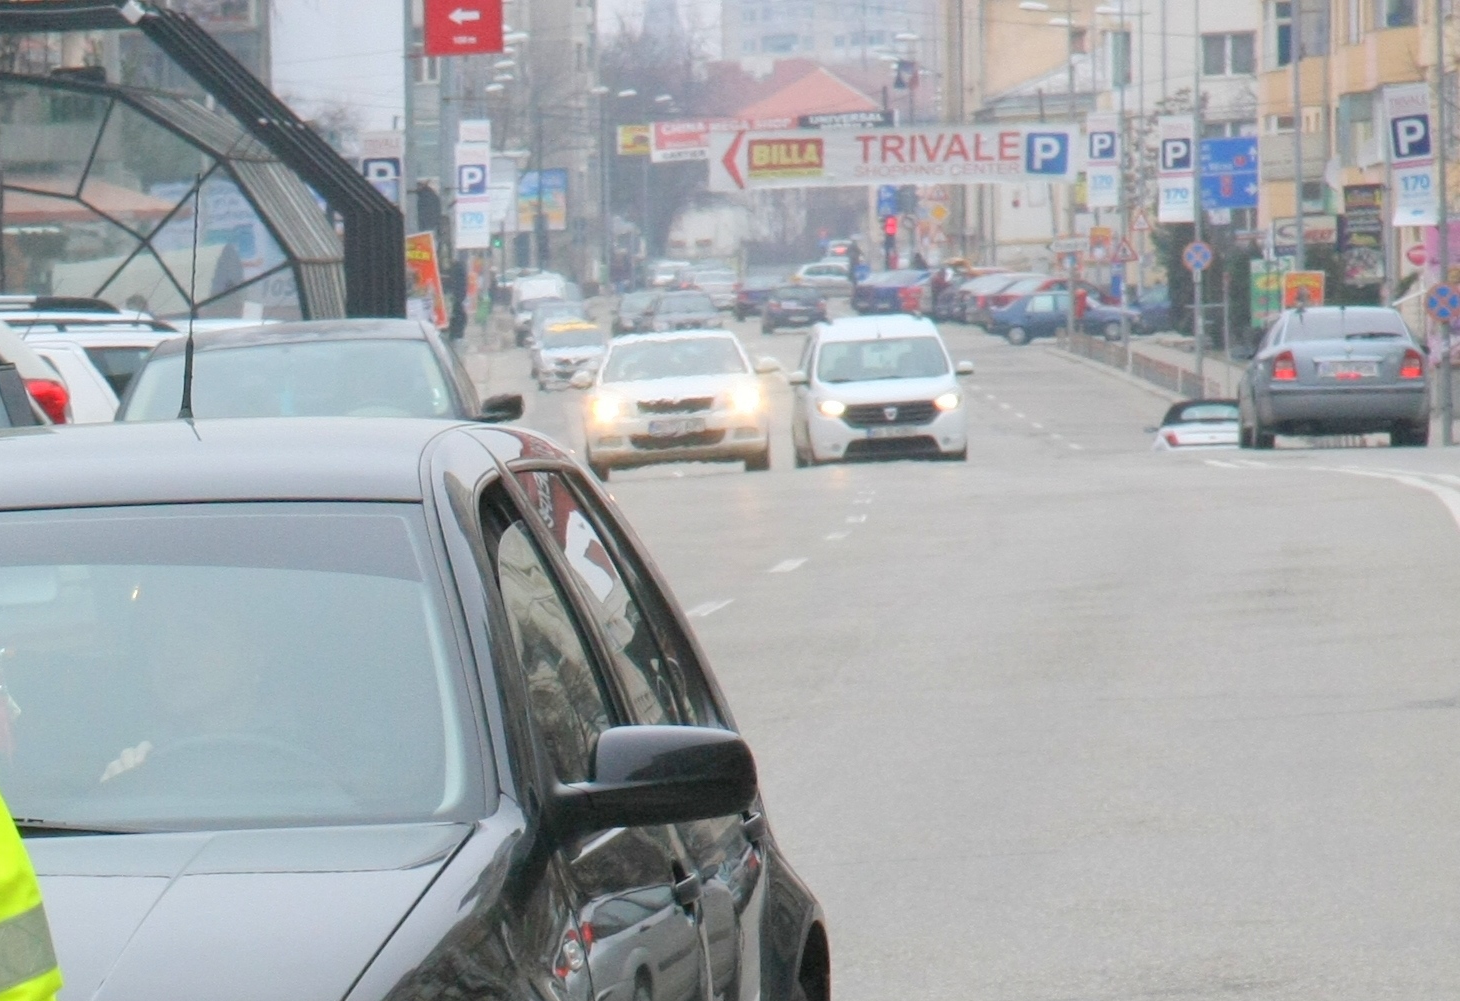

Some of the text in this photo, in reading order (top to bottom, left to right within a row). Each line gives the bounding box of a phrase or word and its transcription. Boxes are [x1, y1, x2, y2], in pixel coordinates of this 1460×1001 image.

[1092, 133, 1112, 157] P
[1397, 119, 1424, 155] P
[753, 143, 819, 166] BILLA
[856, 131, 1060, 170] TRIVALE P
[1165, 141, 1187, 167] P
[461, 166, 483, 193] P
[854, 162, 1020, 177] SHOPPING CENTER
[1165, 188, 1189, 200] 170
[1402, 174, 1430, 191] 170
